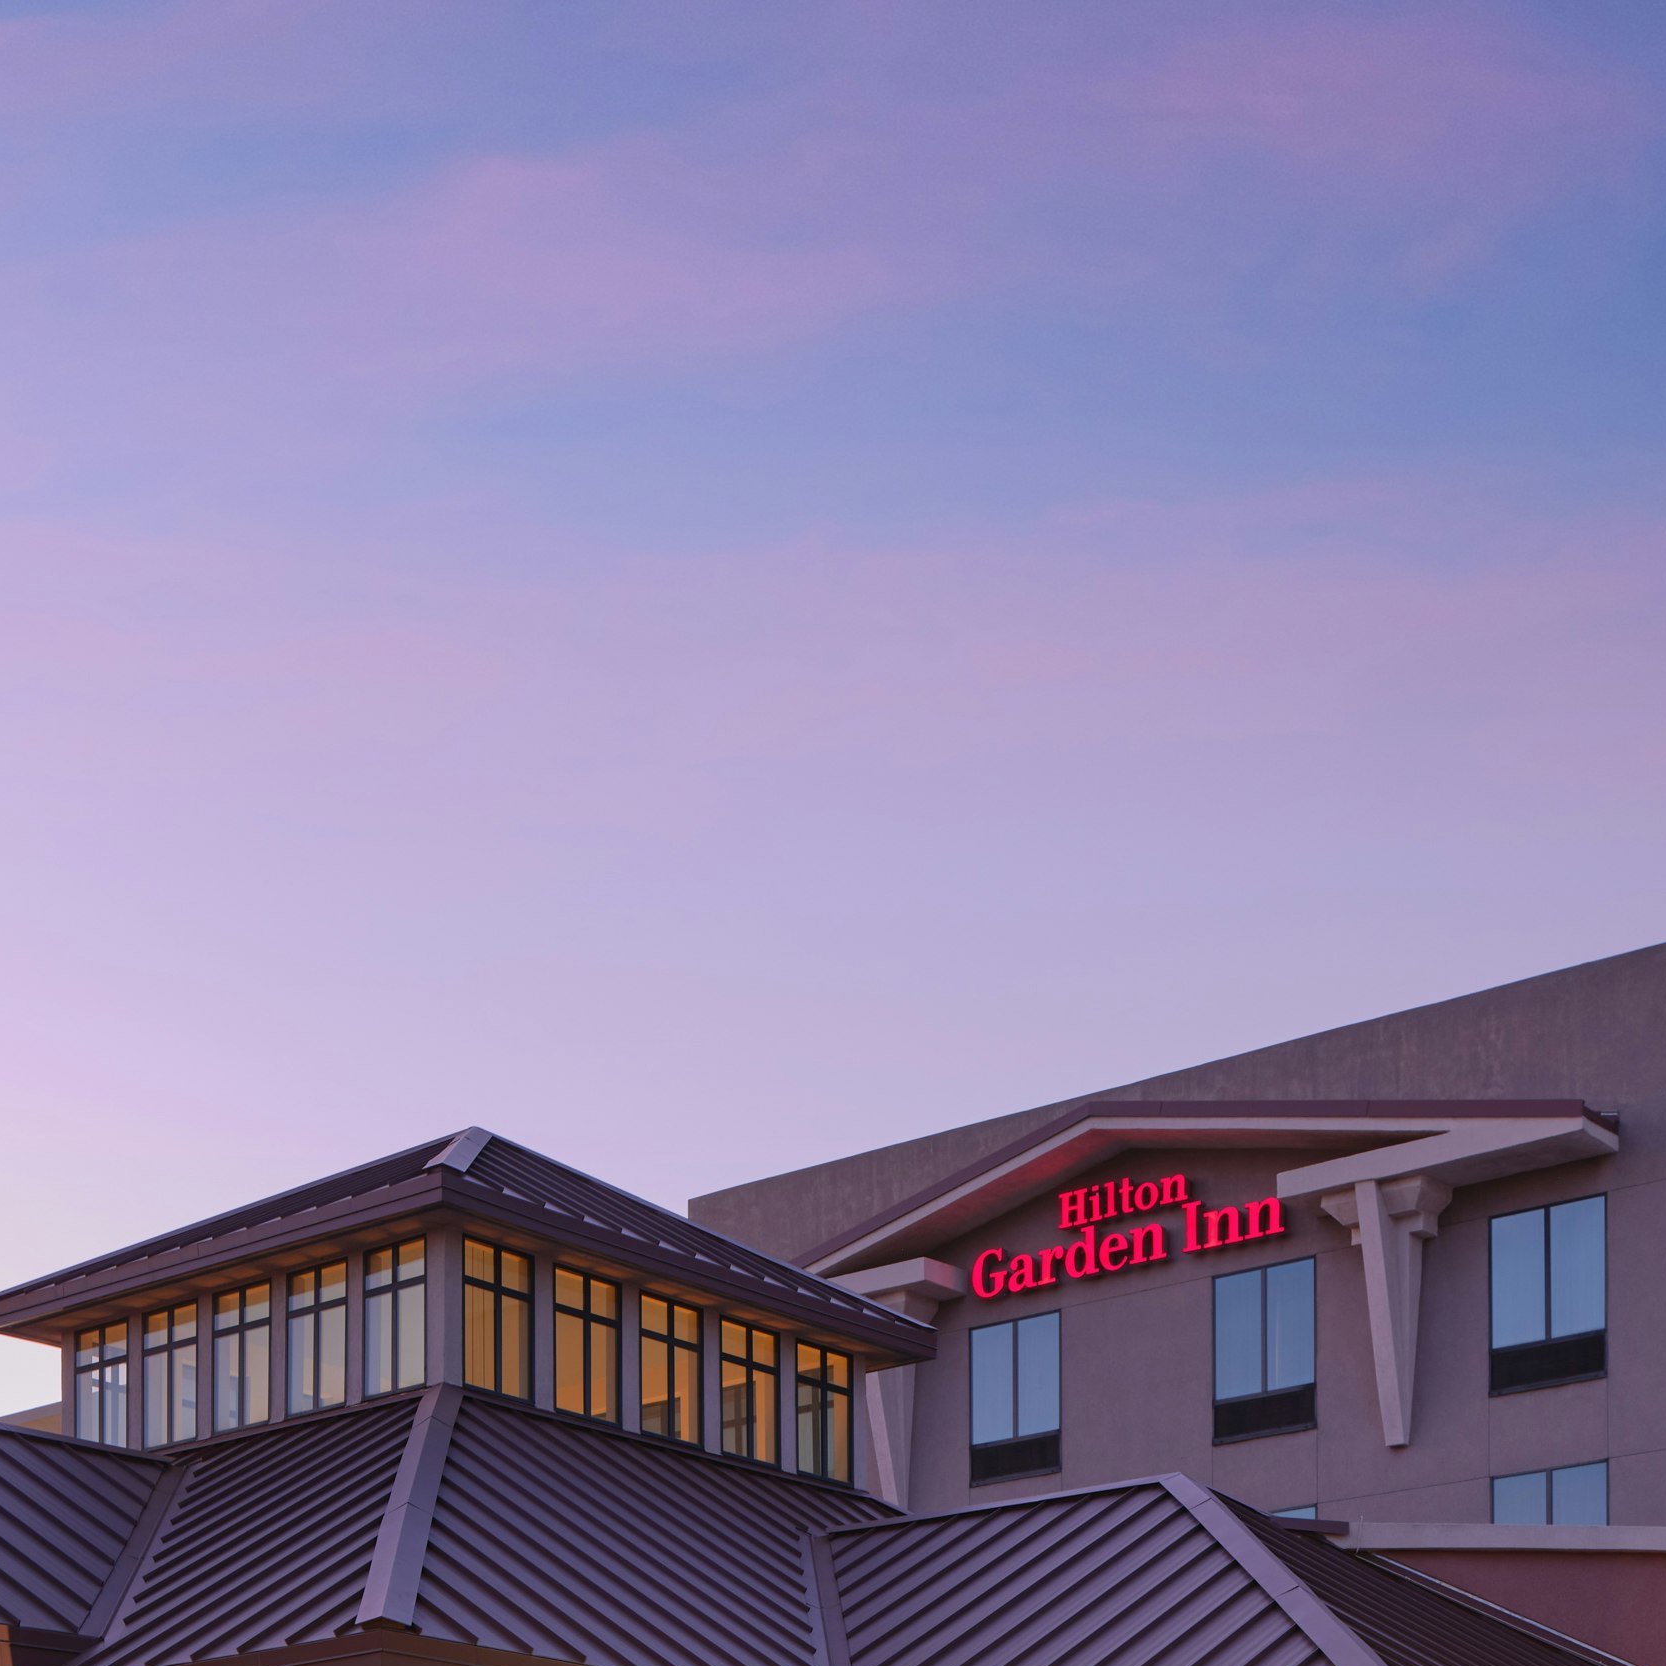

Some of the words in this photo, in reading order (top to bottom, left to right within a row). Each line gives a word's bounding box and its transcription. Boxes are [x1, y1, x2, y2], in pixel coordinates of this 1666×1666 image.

[1058, 1174, 1188, 1229] Hilton
[971, 1223, 1168, 1299] Garden
[1181, 1196, 1286, 1253] Inn
